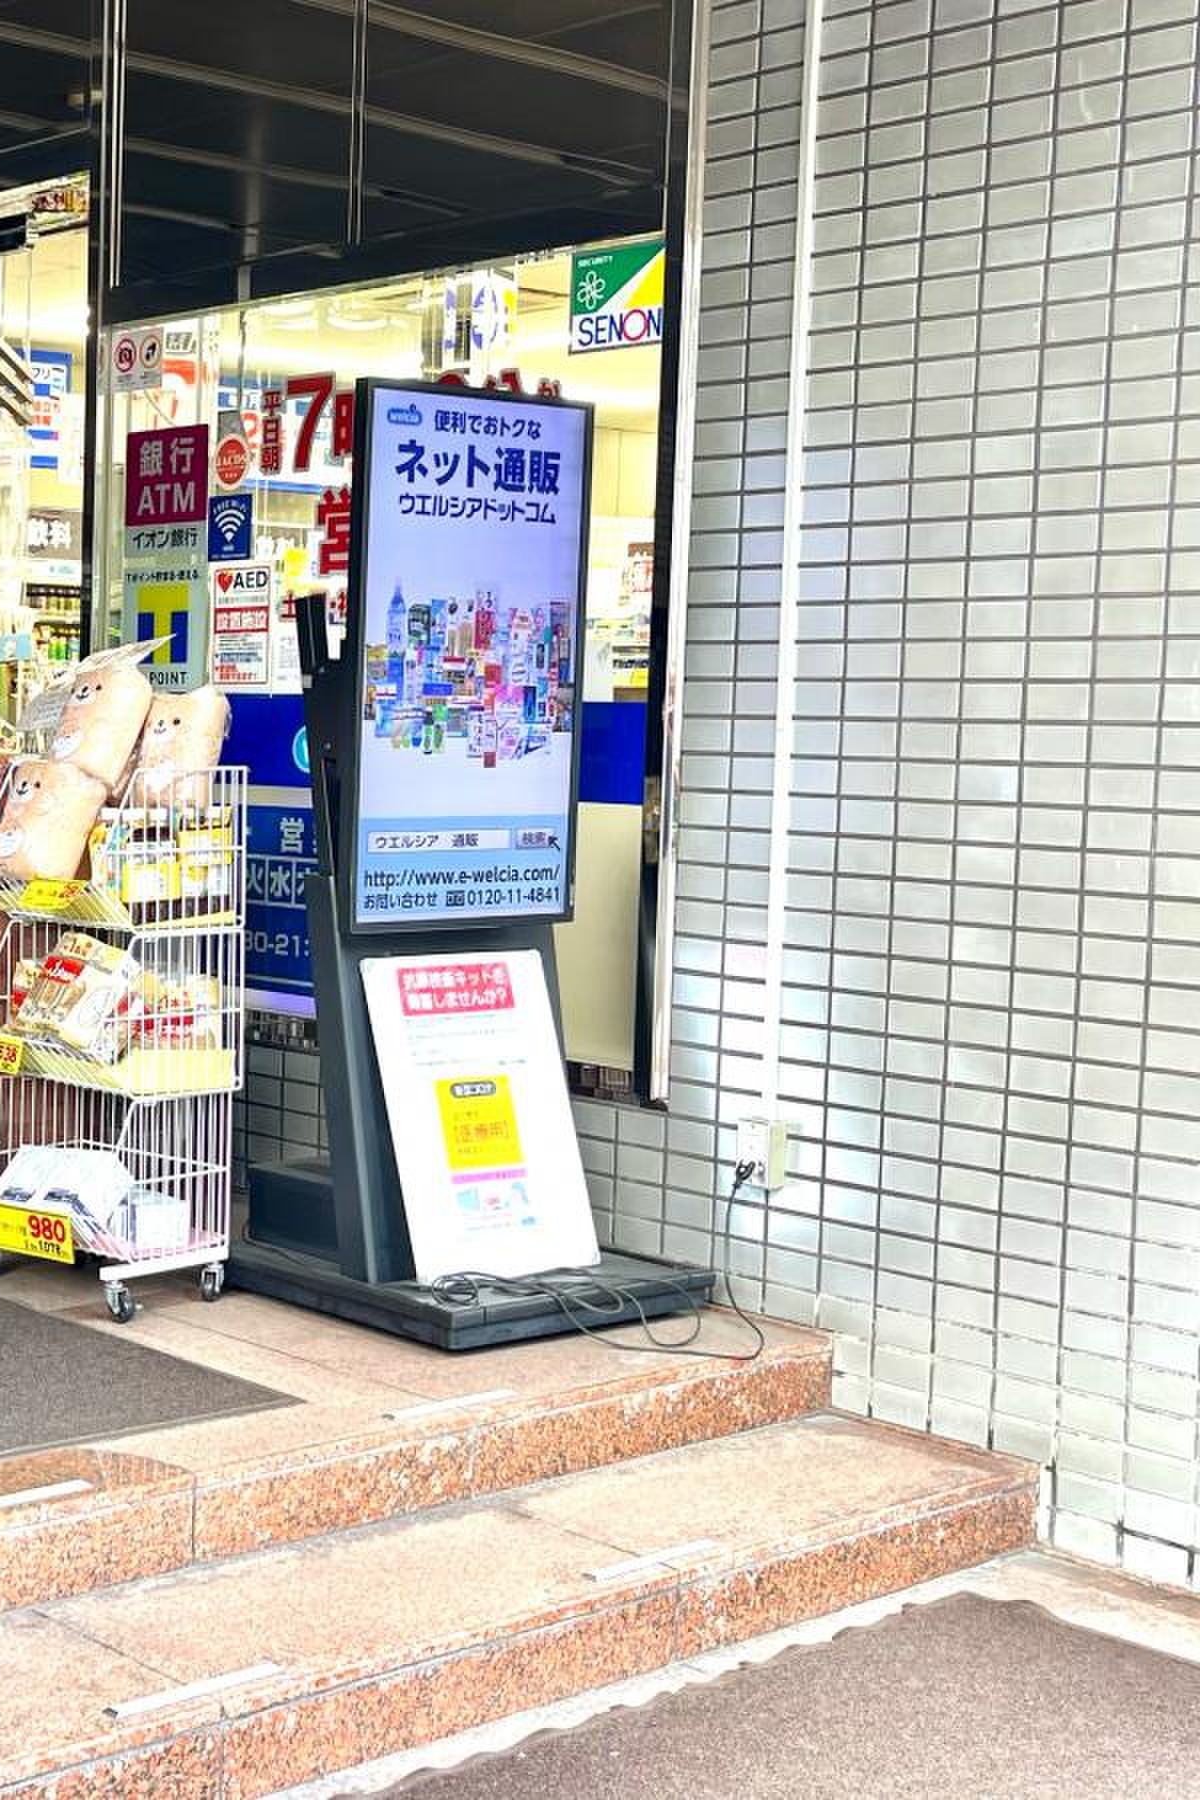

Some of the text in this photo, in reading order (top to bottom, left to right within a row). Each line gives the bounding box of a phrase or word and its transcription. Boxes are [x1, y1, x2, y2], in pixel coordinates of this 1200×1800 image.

[577, 308, 662, 346] SENON
[434, 409, 542, 440] 便利でおトクな
[139, 436, 196, 477] 銀行
[395, 438, 561, 495] ネット通販
[137, 481, 196, 516] ATM
[399, 492, 557, 524] ウエルシアドットコム
[132, 527, 198, 550] イオン銀行
[233, 571, 267, 589] AED
[149, 671, 188, 686] POINT
[375, 833, 480, 849] ウエルシア 通販
[270, 865, 290, 897] 水
[363, 863, 560, 891] http://www.e-welcia.com/
[363, 891, 439, 910] お問い合わせ
[28, 1215, 66, 1244] 980
